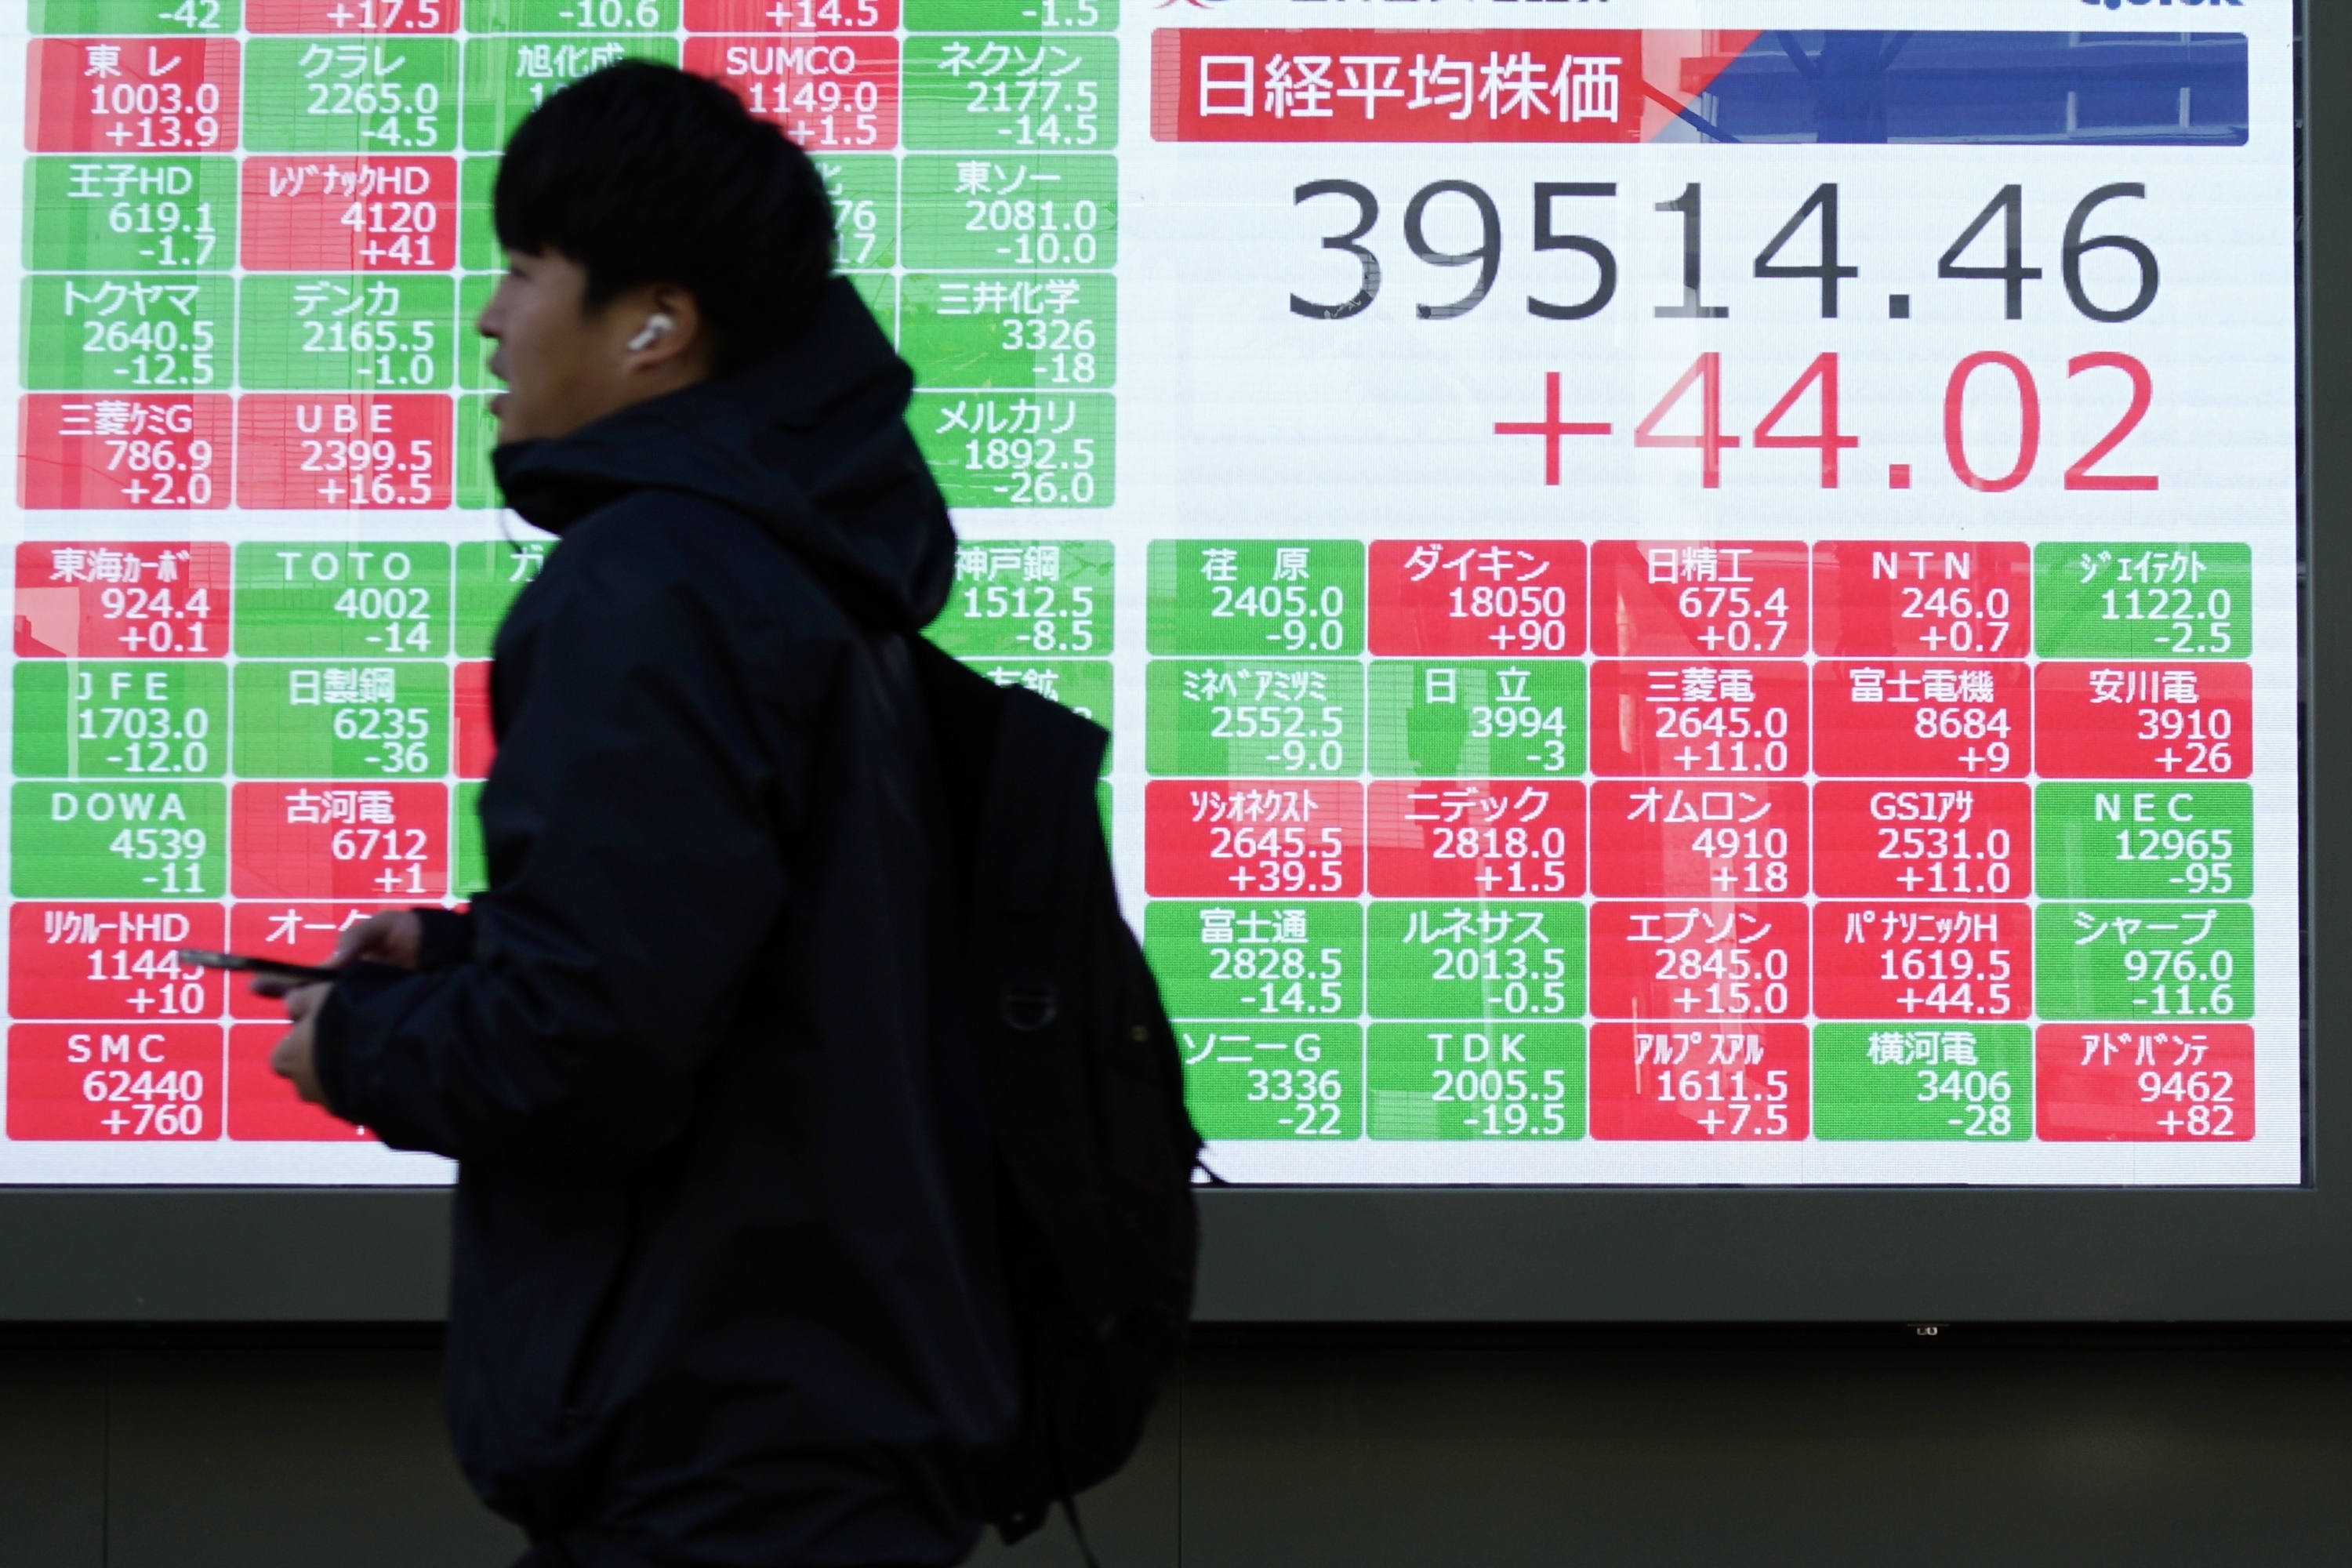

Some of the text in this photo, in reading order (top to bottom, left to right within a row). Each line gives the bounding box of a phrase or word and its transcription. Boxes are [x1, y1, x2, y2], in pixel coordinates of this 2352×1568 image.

[158, 0, 220, 28] -42
[327, 0, 440, 28] +17.5
[559, 0, 659, 28] -10.6
[766, 0, 878, 27] +14.5
[1022, 0, 1098, 27] -1.5
[299, 44, 407, 77] クラレ
[727, 46, 855, 75] SUMCO
[938, 42, 1083, 77] ネクソン
[90, 84, 219, 114] 1003.0
[306, 84, 437, 114] 2265.0
[749, 81, 877, 113] 1149.0
[967, 81, 1098, 112] 2177.5
[1198, 51, 1622, 123] 日経平均株価
[105, 116, 219, 147] +13.9
[360, 116, 437, 146] -4.5
[787, 115, 877, 146] +1.5
[998, 114, 1098, 145] -14.5
[67, 166, 192, 198] 王子HD
[954, 161, 1061, 194] 東ソー
[109, 203, 216, 234] 619.1
[341, 203, 437, 232] 4120
[965, 201, 1096, 231] 2081.0
[140, 235, 215, 266] -1.7
[359, 236, 434, 266] +41
[996, 234, 1096, 264] -10.0
[1288, 177, 2160, 325] 39514.46
[64, 282, 199, 315] トクヤマ
[292, 281, 399, 315] デンカ
[936, 279, 1079, 314] 三井化学
[82, 321, 214, 351] 2640.5
[302, 321, 434, 351] 2165.5
[1002, 321, 1094, 351] 3326
[114, 354, 213, 384] -12.5
[356, 354, 434, 384] -1.0
[1032, 354, 1094, 384] -18
[296, 405, 394, 433] UBE
[935, 399, 1076, 434] メルカリ
[1494, 350, 2160, 493] +44.02
[106, 441, 212, 471] 786.9
[300, 441, 432, 471] 2399.5
[965, 440, 1094, 470] 1892.5
[122, 474, 212, 504] +2.0
[318, 474, 432, 503] +16.5
[994, 471, 1093, 503] -26.0
[277, 552, 411, 580] TOTO
[1405, 544, 1549, 581] ダイキン
[1649, 547, 1754, 584] 日精工
[1872, 552, 1970, 579] NTN
[100, 588, 209, 619] 924.4
[335, 588, 430, 619] 4002
[964, 586, 1093, 618] 1512.5
[1211, 586, 1343, 617] 2405.0
[1450, 586, 1566, 617] 18050
[1679, 588, 1789, 618] 675.4
[1901, 588, 2009, 618] 246.0
[2101, 589, 2231, 620] 1122.0
[118, 622, 209, 652] +0.1
[365, 622, 430, 652] -14
[1015, 619, 1093, 652] -8.5
[1266, 619, 1343, 650] -9.0
[1488, 620, 1566, 651] +90
[1697, 621, 1788, 651] +0.7
[1919, 621, 2009, 652] +0.7
[2154, 622, 2231, 653] -2.5
[76, 672, 169, 701] JFE
[289, 669, 396, 705] 日製鋼
[1646, 667, 1755, 702] 三菱電
[1849, 667, 1994, 703] 富士電機
[2089, 669, 2199, 704] 安川電
[77, 708, 208, 739] 1703.0
[333, 708, 430, 739] 6235
[1210, 707, 1343, 738] 2552.5
[1471, 707, 1566, 738] 3994
[1656, 708, 1788, 739] 2645.0
[1915, 708, 2011, 739] 8684
[2138, 709, 2232, 740] 3910
[106, 742, 208, 772] -12.0
[365, 742, 430, 772] -36
[1265, 740, 1342, 771] -9.0
[1527, 742, 1566, 771] -3
[1673, 742, 1788, 771] +11.0
[1958, 742, 2010, 772] +9
[2154, 742, 2232, 773] +26
[52, 792, 186, 821] DOWA
[285, 789, 395, 824] 古河電
[1405, 787, 1549, 822] ニデック
[1627, 788, 1771, 822] オムロン
[2095, 793, 2194, 822] NEC
[109, 828, 206, 859] 4539
[332, 828, 427, 859] 6712
[1210, 827, 1342, 858] 2645.5
[1433, 827, 1565, 858] 2818.0
[1692, 829, 1788, 859] 4910
[1878, 829, 2010, 859] 2531.0
[2115, 829, 2232, 860] 12965
[141, 862, 205, 893] -11
[373, 863, 426, 893] +1
[1229, 862, 1342, 891] +39.5
[1475, 862, 1565, 891] +1.5
[1711, 862, 1788, 892] +18
[1896, 862, 2010, 893] +11.0
[2169, 862, 2232, 893] -95
[1200, 909, 1308, 944] 富士通
[1403, 910, 1548, 944] ルネサス
[1626, 909, 1772, 944] エプソン
[2074, 909, 2216, 946] シャープ
[1210, 948, 1341, 979] 2828.5
[1432, 948, 1565, 979] 2013.5
[1655, 949, 1788, 980] 2845.0
[1881, 949, 2011, 981] 1619.5
[2124, 950, 2233, 982] 976.0
[126, 983, 204, 1014] +10
[1241, 982, 1341, 1013] -14.5
[1486, 982, 1565, 1013] -0.5
[1673, 982, 1788, 1014] +15.0
[1896, 983, 2011, 1014] +44.5
[2132, 984, 2233, 1015] -11.6
[67, 1034, 165, 1062] SMC
[1183, 1033, 1322, 1065] ソニーG
[1428, 1033, 1526, 1062] TDK
[1867, 1031, 1978, 1065] 横河電
[82, 1069, 204, 1102] 62440
[1247, 1069, 1341, 1101] 3336
[1432, 1070, 1565, 1102] 2005.5
[1657, 1071, 1788, 1102] 1611.5
[1917, 1071, 2011, 1102] 3406
[2138, 1071, 2234, 1102] 9462
[101, 1104, 202, 1135] +760
[1278, 1104, 1341, 1135] -22
[1464, 1104, 1565, 1135] -19.5
[1697, 1105, 1788, 1135] +7.5
[1947, 1105, 2011, 1135] -28
[2157, 1105, 2234, 1136] +82
